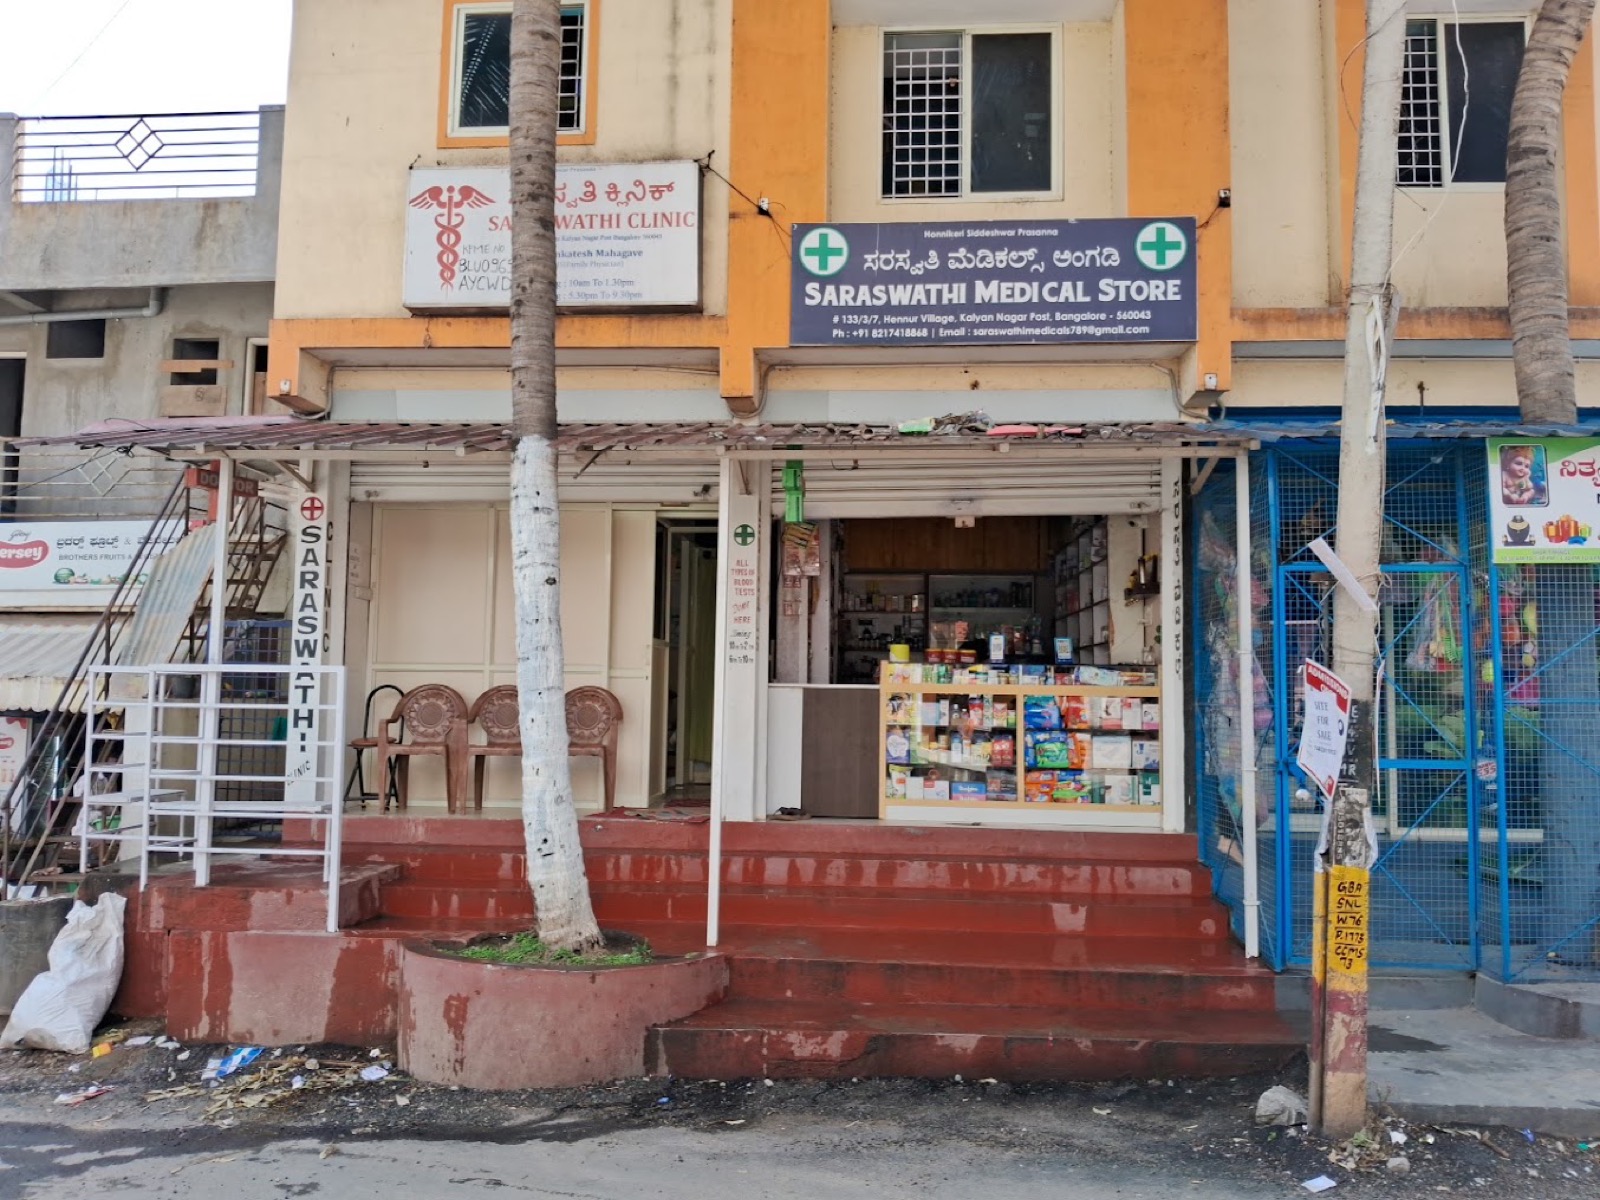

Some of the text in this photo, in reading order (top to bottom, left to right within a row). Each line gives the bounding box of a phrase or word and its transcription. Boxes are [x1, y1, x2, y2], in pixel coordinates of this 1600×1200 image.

[605, 179, 675, 208] ಕ್ಲಿನಿಕ್
[488, 211, 695, 232] SAWATHI CLINIC
[966, 228, 1016, 237] Siddeshwar
[1017, 228, 1059, 237] Prasanna
[596, 248, 644, 259] Mahagave
[863, 249, 940, 275] ಸರಸ್ವತಿ
[1052, 244, 1121, 268] ಅಂಗಡಿ
[592, 279, 602, 287] To
[601, 291, 611, 299] To
[804, 278, 1182, 307] SARASWATHI MEDICAL STORE
[841, 314, 882, 325] 133/3/7,
[883, 314, 918, 323] Hennur
[920, 313, 958, 326] Village,
[959, 312, 995, 324] Kalyan
[996, 312, 1026, 324] Nagar
[1029, 311, 1053, 322] Post,
[1054, 311, 1107, 323] Bangalore
[1116, 310, 1152, 321] 560043
[832, 328, 845, 339] Ph
[938, 327, 966, 337] Email
[200, 472, 255, 495] DOOR
[0, 546, 44, 561] ersey
[58, 553, 99, 561] BROTHERS
[1337, 880, 1363, 895] GBA
